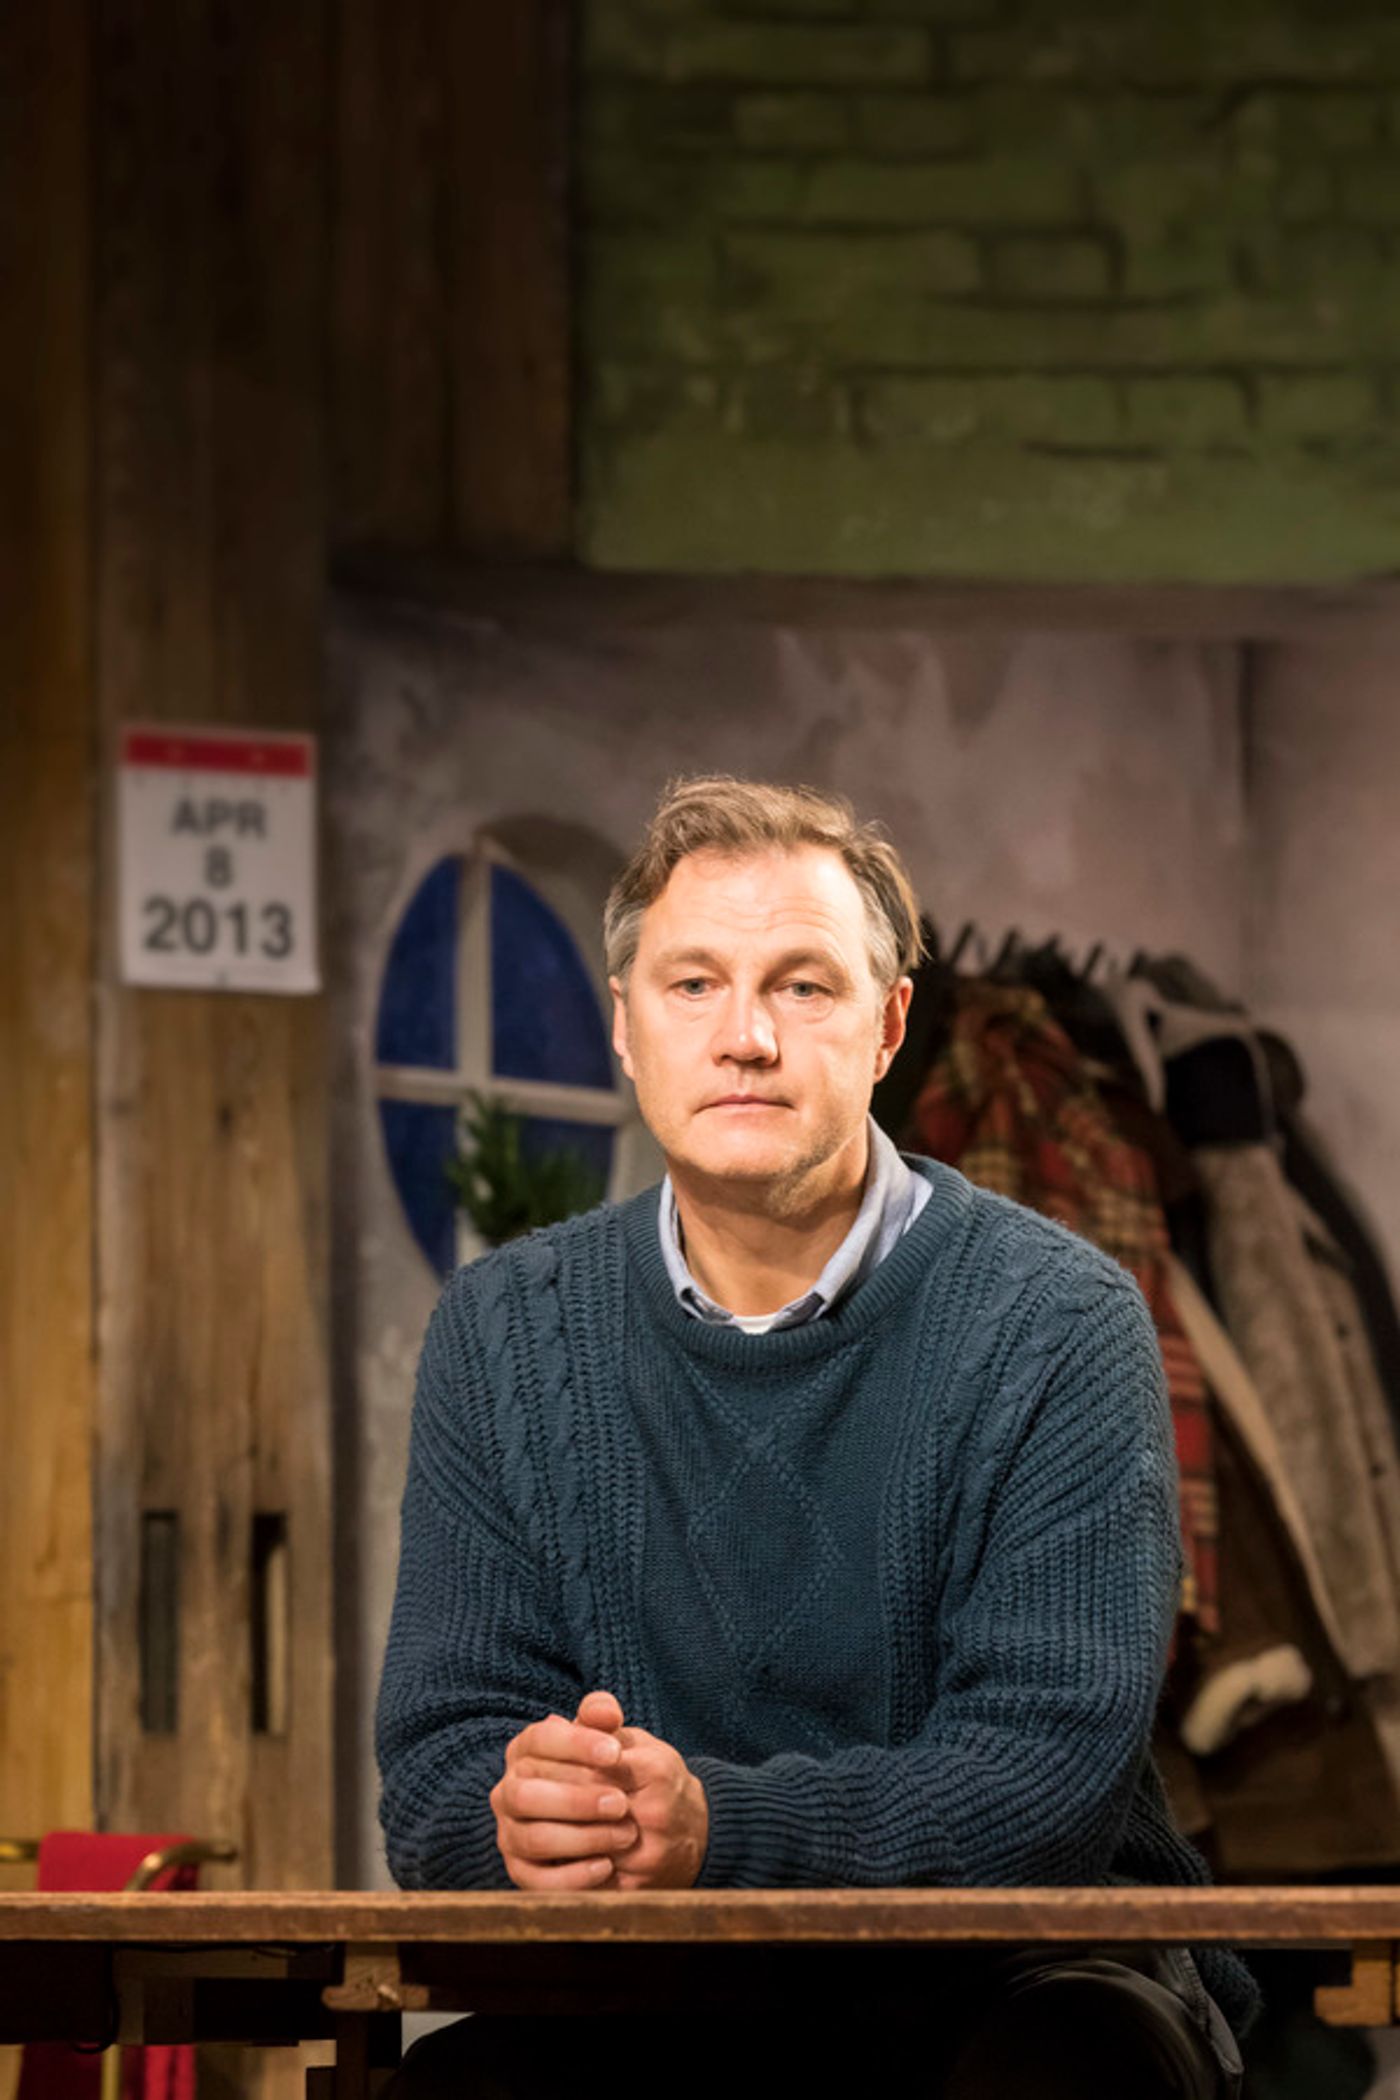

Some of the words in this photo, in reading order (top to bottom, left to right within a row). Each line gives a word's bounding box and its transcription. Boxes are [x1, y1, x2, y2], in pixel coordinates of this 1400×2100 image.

[171, 797, 267, 840] APR
[205, 845, 233, 890] 8
[143, 895, 295, 960] 2013
